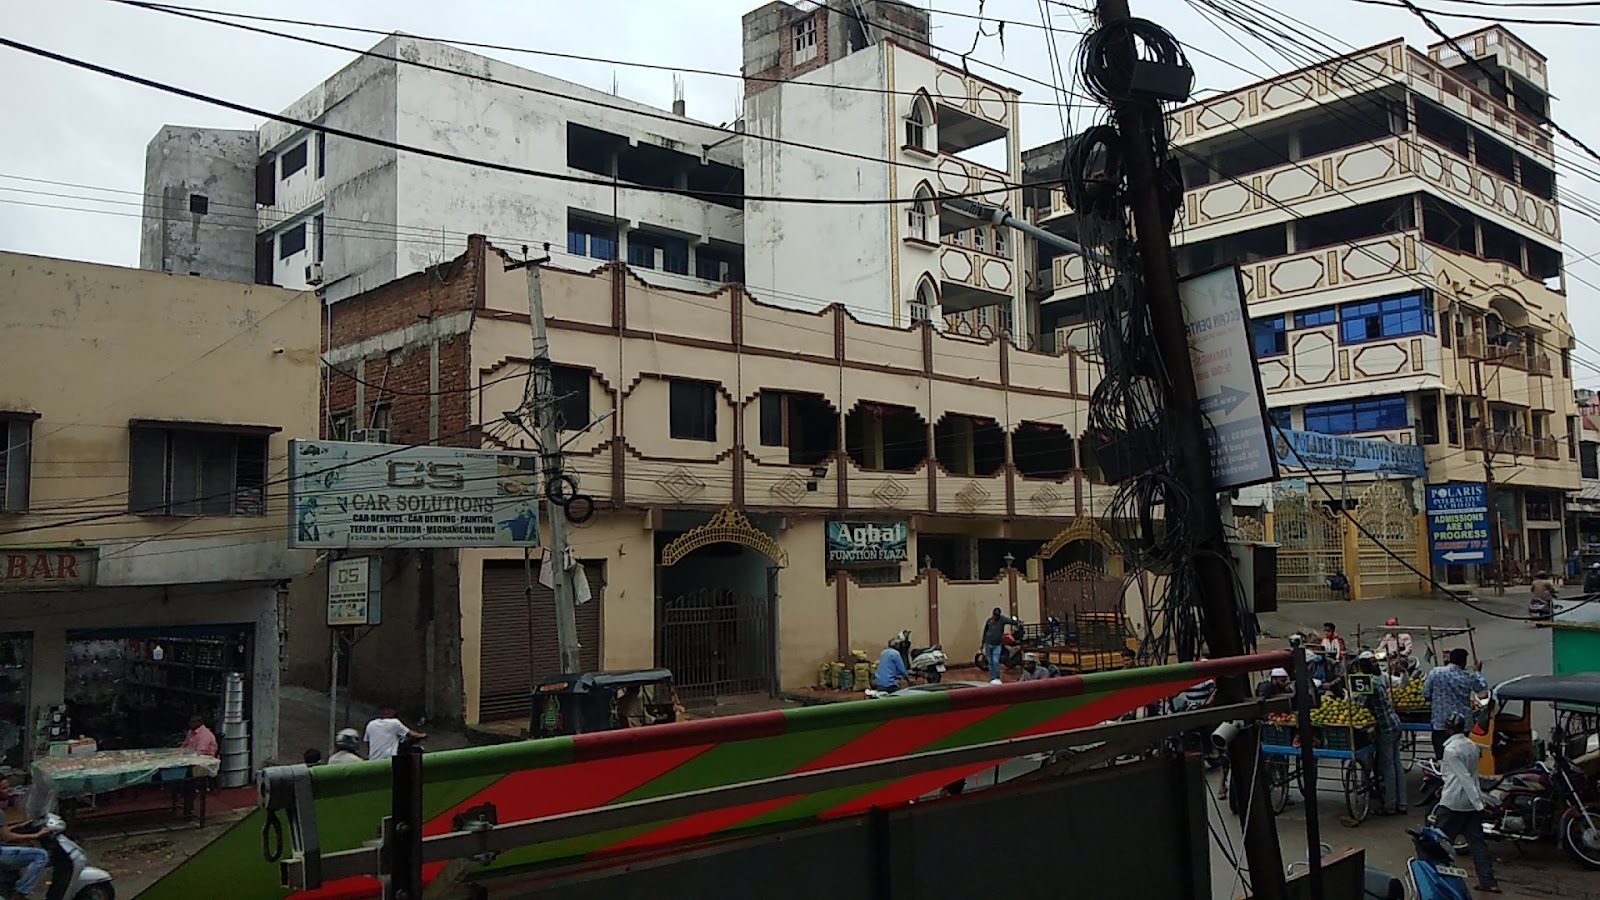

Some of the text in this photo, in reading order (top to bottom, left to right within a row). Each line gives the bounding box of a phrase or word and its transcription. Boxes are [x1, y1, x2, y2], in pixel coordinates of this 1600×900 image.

[386, 459, 464, 491] CS
[1431, 486, 1483, 499] POLARIS
[352, 494, 494, 513] CAR SOLUTIONS
[408, 514, 424, 524] CAR
[425, 515, 456, 524] DENTING
[460, 515, 493, 525] PAINTING
[1434, 512, 1485, 524] ADMISSIONS
[350, 525, 378, 534] TEFLON
[386, 525, 422, 535] INTERIOR
[427, 525, 473, 535] MECHANICAL
[474, 526, 496, 535] WORK
[1446, 521, 1474, 531] ARE IN
[1433, 529, 1488, 540] PROGRESS
[829, 549, 878, 561] FUNCTION
[3, 552, 80, 581] BAR
[338, 568, 359, 584] CS
